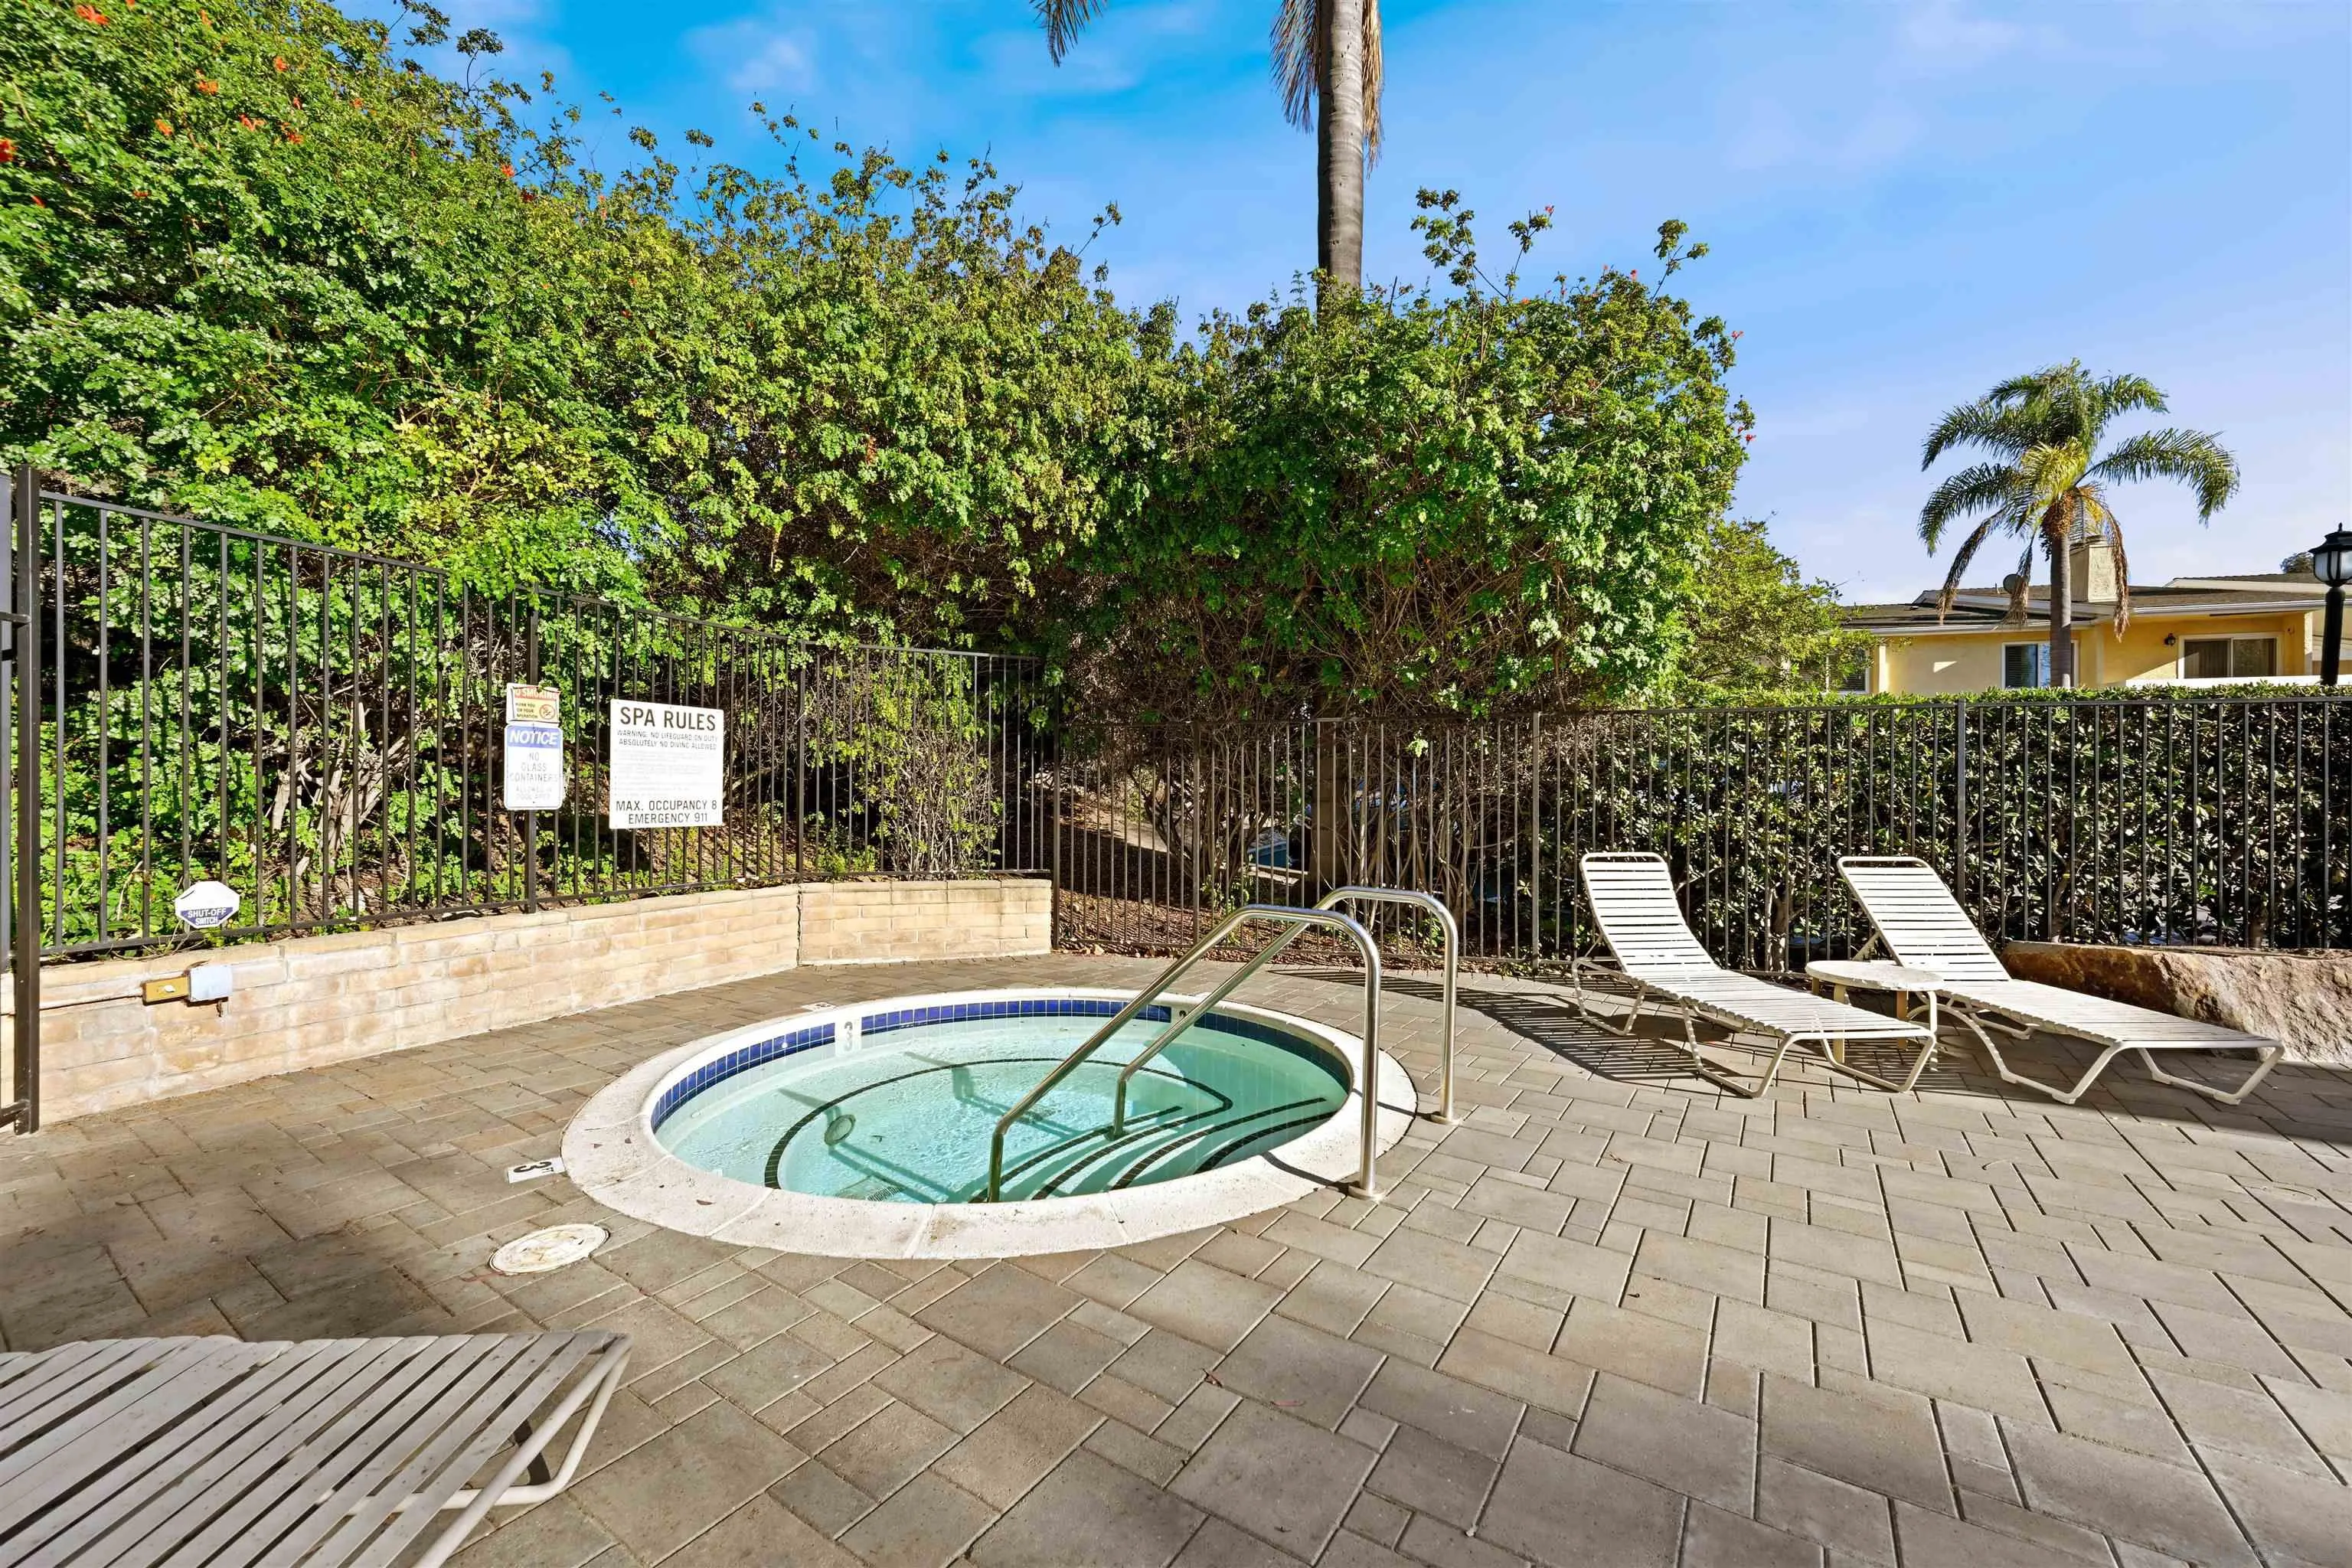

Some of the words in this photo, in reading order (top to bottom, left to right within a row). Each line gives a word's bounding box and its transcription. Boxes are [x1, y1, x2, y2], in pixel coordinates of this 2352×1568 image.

[620, 706, 655, 727] SPA
[664, 710, 716, 731] RULES
[509, 730, 558, 746] NOTICE
[619, 738, 658, 747] ABSOLUTELY
[529, 752, 540, 761] NO
[521, 762, 547, 772] GLASS
[509, 772, 558, 782] CONTAINERS
[616, 800, 644, 812] MAX.
[648, 800, 707, 812] OCCUPANCY
[711, 799, 717, 810] 8
[629, 812, 690, 825] EMERGENCY
[694, 812, 708, 822] 911
[188, 908, 227, 918] SHUT-OFF
[195, 916, 218, 926] SWITCH
[514, 1161, 552, 1173] 3
